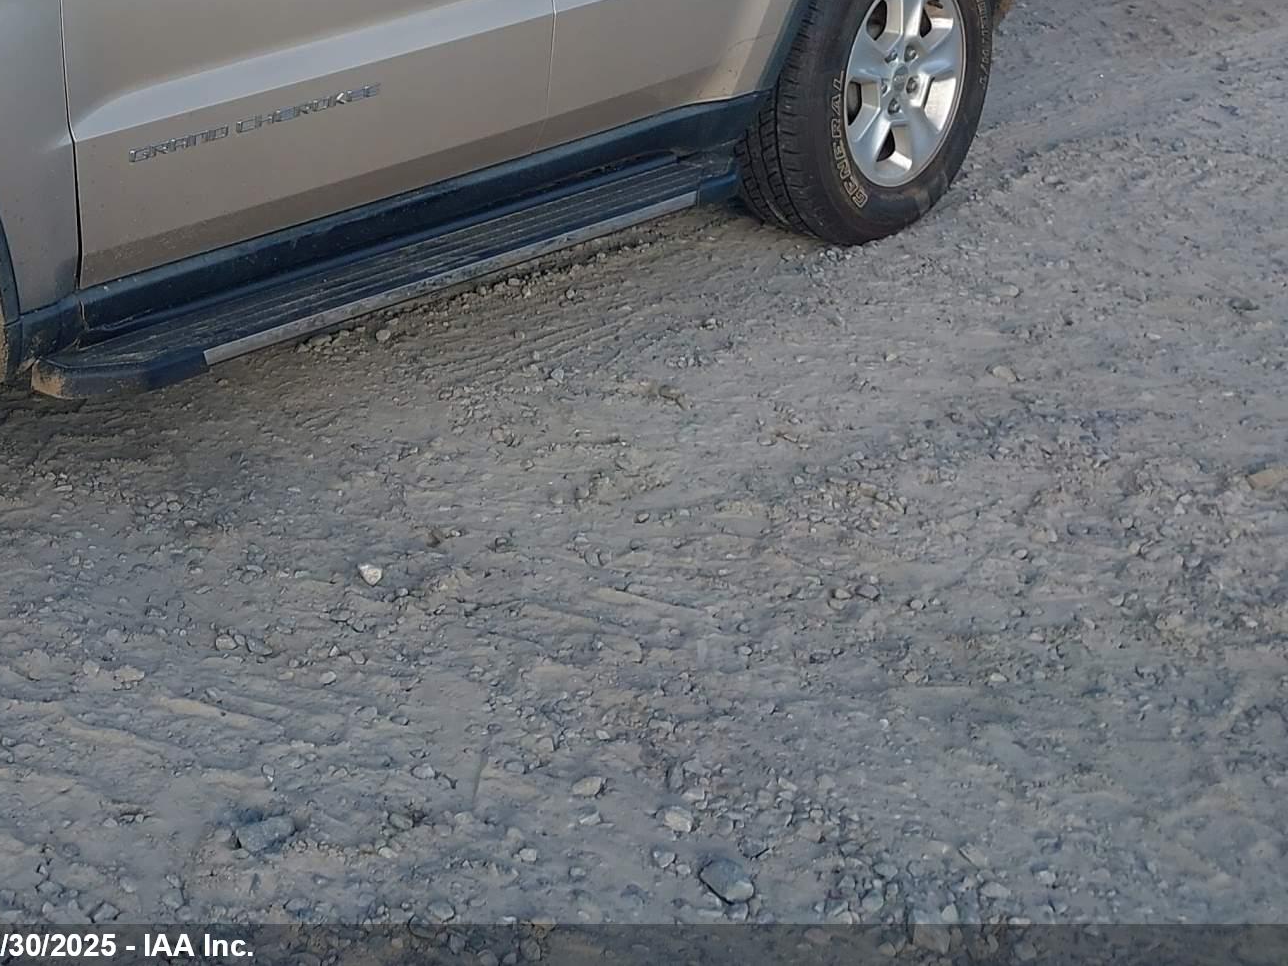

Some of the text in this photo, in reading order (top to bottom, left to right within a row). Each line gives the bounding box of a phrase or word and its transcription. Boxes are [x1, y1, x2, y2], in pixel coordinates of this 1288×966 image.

[129, 83, 381, 163] GRAND CHEROKEE
[829, 69, 869, 208] GENERAL
